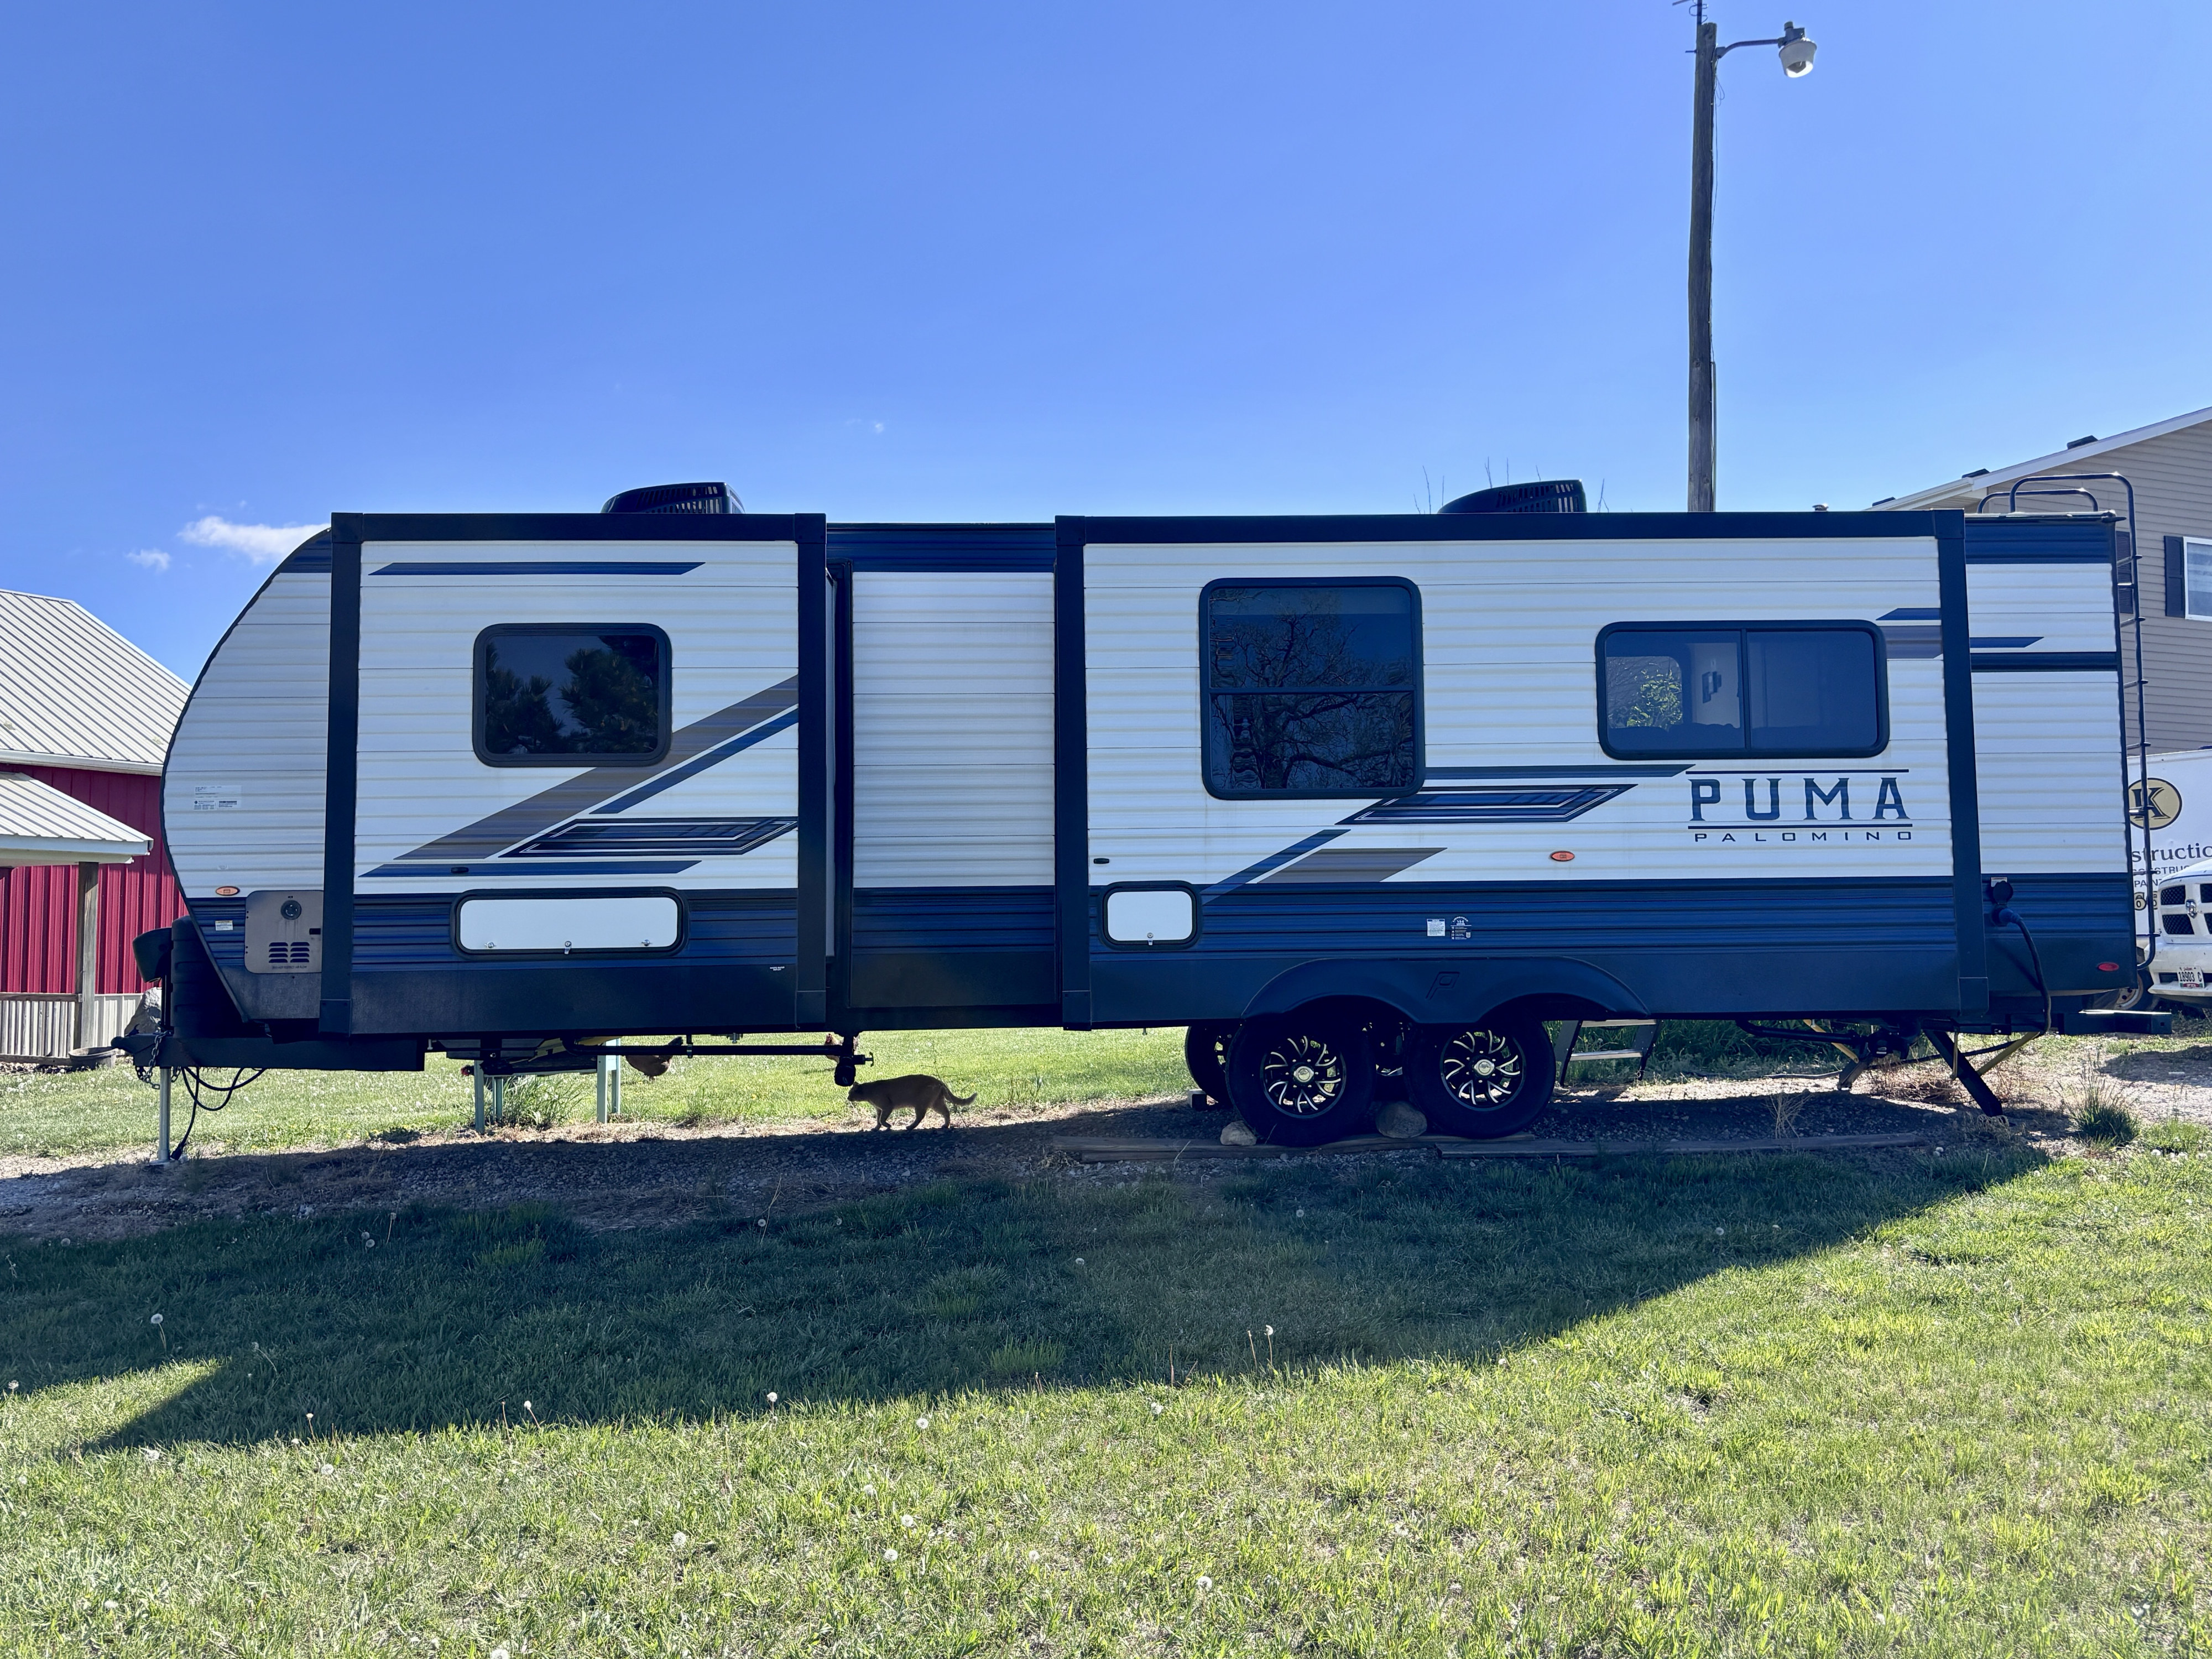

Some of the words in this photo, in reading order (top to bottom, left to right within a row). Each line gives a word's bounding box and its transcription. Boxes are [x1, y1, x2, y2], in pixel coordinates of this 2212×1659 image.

[1688, 777, 1911, 821] PUMA
[2131, 786, 2172, 821] K
[1694, 831, 1912, 842] PALOMINO
[2178, 971, 2195, 982] 18903
[2198, 972, 2202, 982] C
